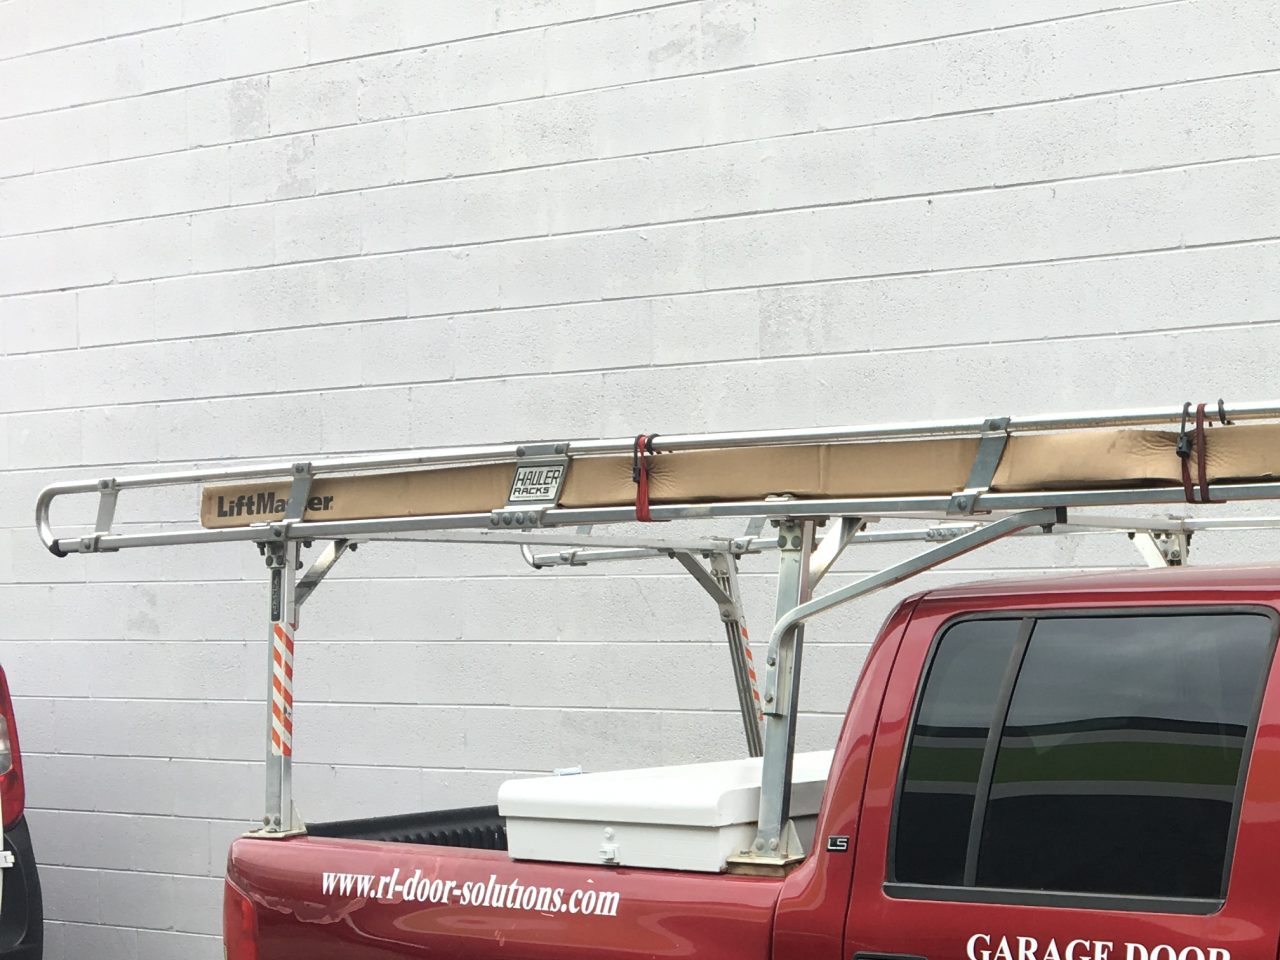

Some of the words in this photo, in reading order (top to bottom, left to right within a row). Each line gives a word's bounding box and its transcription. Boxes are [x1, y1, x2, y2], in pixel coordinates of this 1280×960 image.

[515, 470, 561, 486] HAULER
[512, 487, 550, 495] RACKS
[217, 492, 334, 517] LiftMaer
[827, 838, 848, 849] LS
[321, 868, 620, 916] www.rl-door-solutions.com
